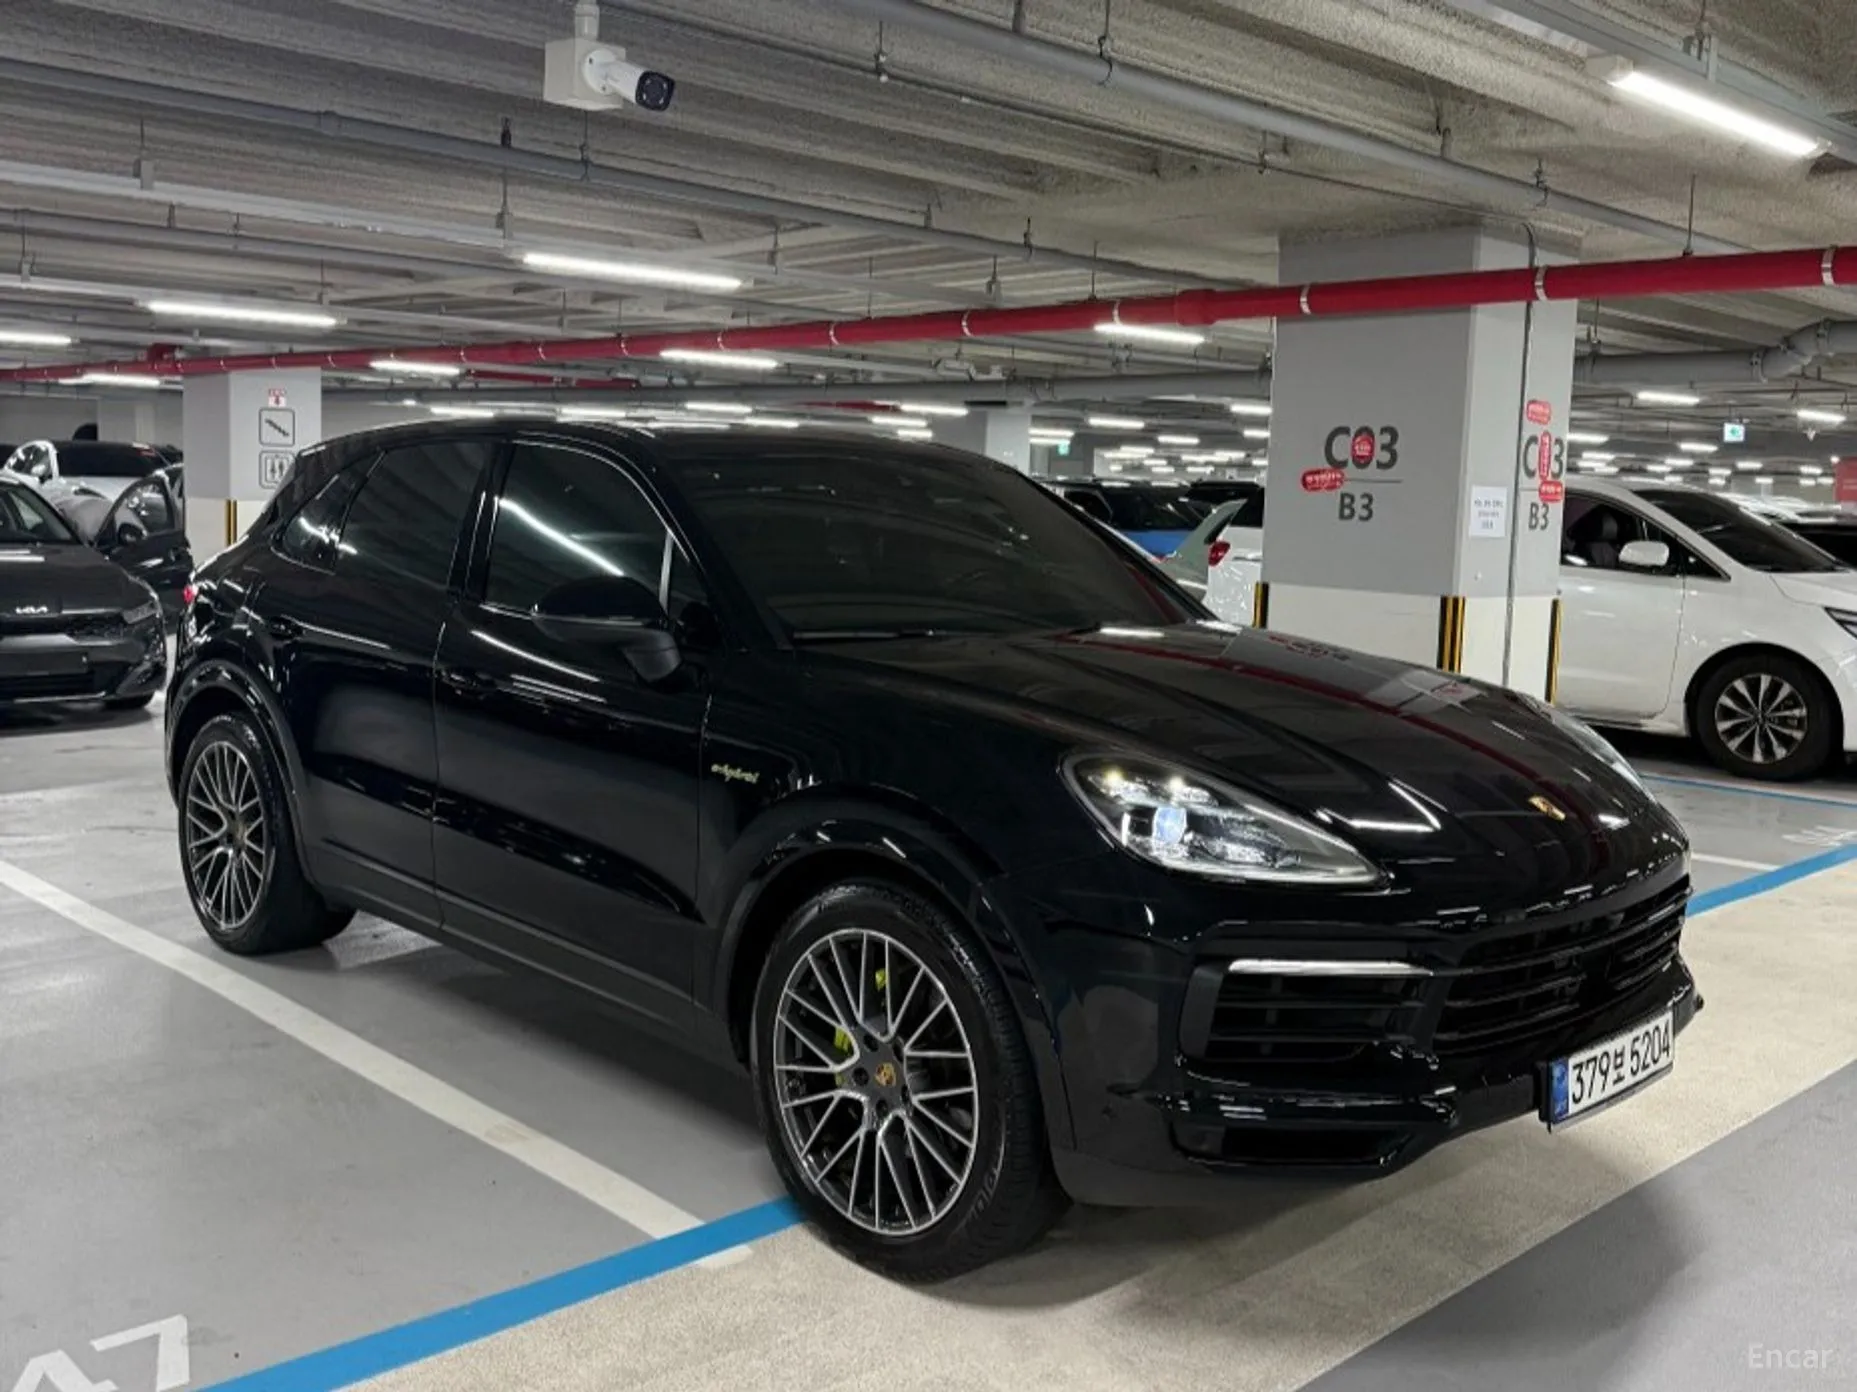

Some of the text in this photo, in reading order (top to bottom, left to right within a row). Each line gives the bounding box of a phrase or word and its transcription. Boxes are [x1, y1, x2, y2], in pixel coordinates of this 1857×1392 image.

[1338, 492, 1374, 521] B3
[1528, 501, 1550, 530] B3
[1572, 1019, 1670, 1104] 379보 5204
